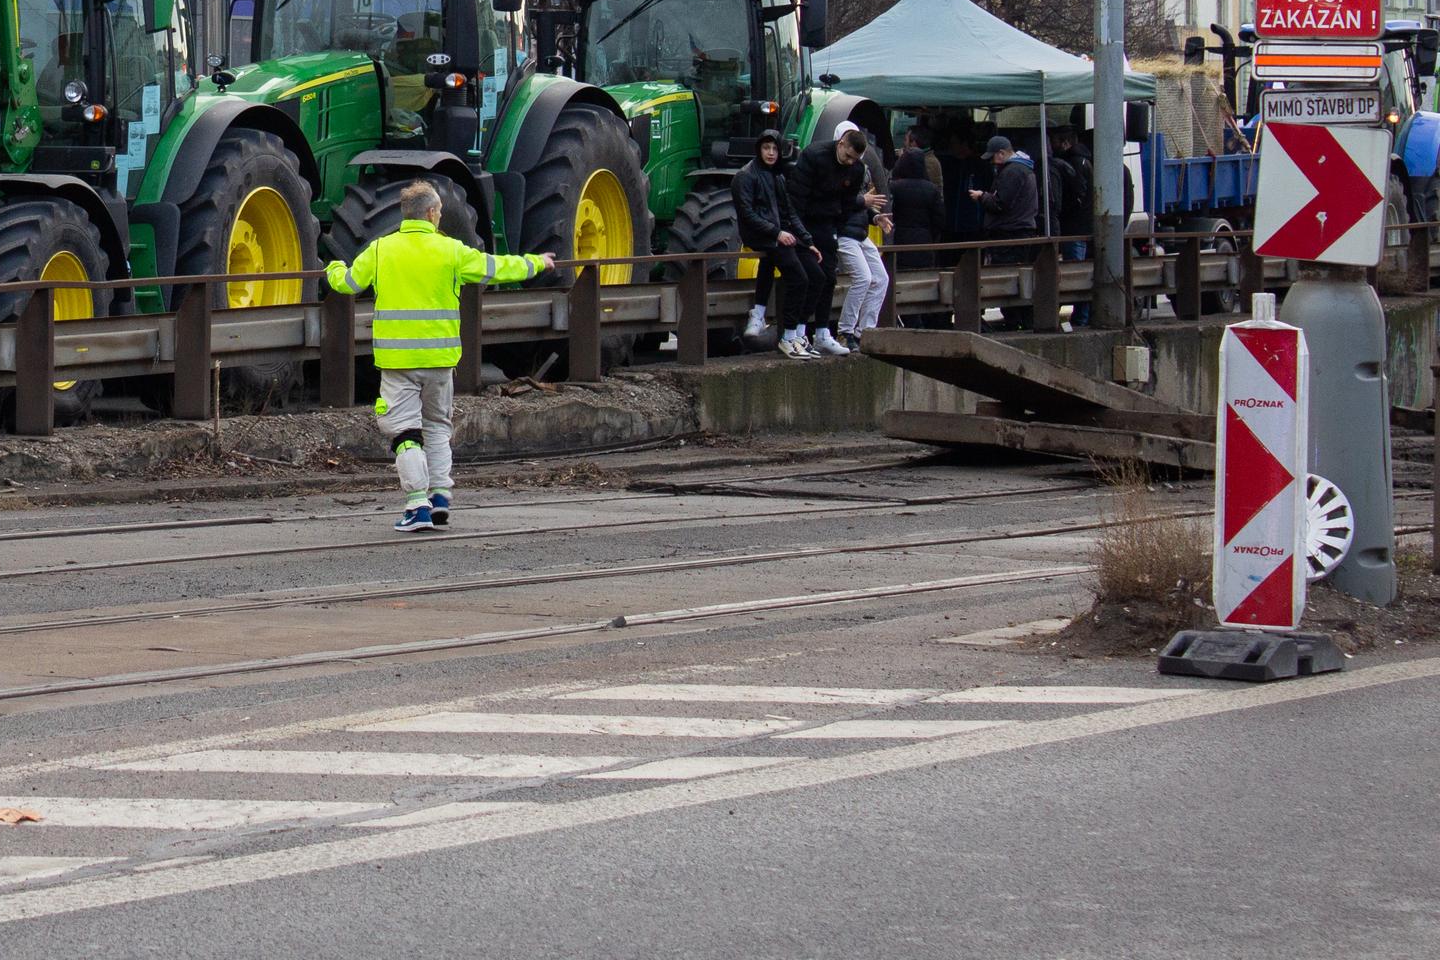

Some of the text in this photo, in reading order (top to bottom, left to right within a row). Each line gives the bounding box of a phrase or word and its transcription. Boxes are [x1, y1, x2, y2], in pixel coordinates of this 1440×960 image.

[1260, 4, 1361, 29] ZAKÁZÁN
[1268, 97, 1375, 118] MIMO STAVBU DP
[1234, 397, 1285, 409] PROZNAK
[1233, 545, 1285, 557] PROZNAK
